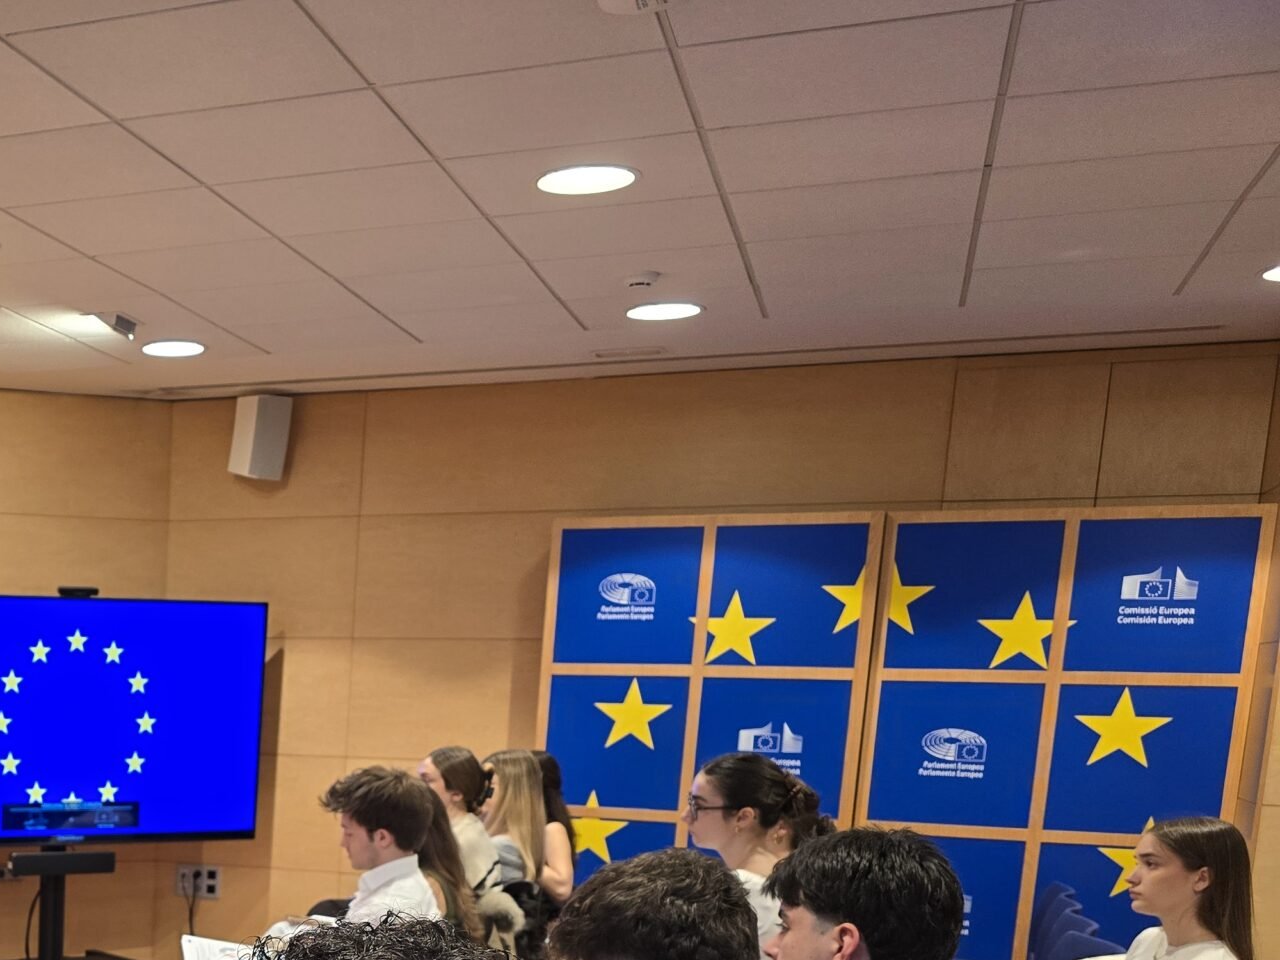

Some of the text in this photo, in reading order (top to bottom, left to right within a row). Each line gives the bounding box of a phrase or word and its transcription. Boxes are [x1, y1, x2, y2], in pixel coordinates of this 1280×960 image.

[1118, 605, 1195, 616] Comissió Europea
[1117, 615, 1194, 626] Comisión Europea
